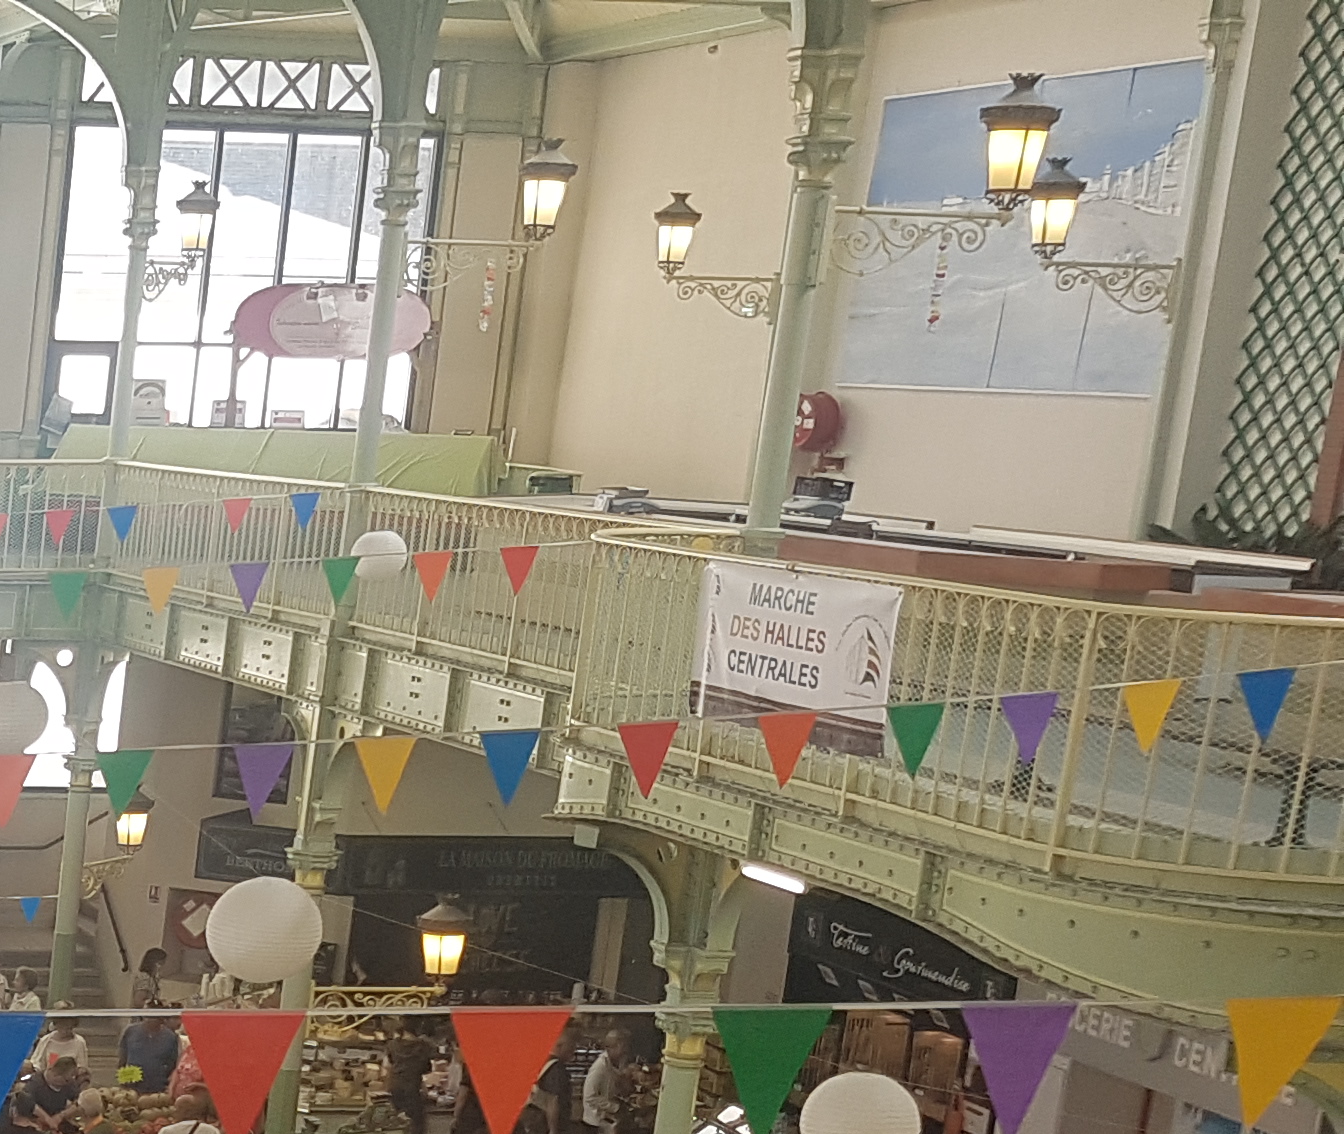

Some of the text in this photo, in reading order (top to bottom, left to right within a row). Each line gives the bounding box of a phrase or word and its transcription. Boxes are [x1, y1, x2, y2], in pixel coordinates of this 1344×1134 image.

[748, 582, 819, 616] MARCHE
[729, 614, 827, 655] DES HALLES
[727, 649, 820, 690] CENTRALES
